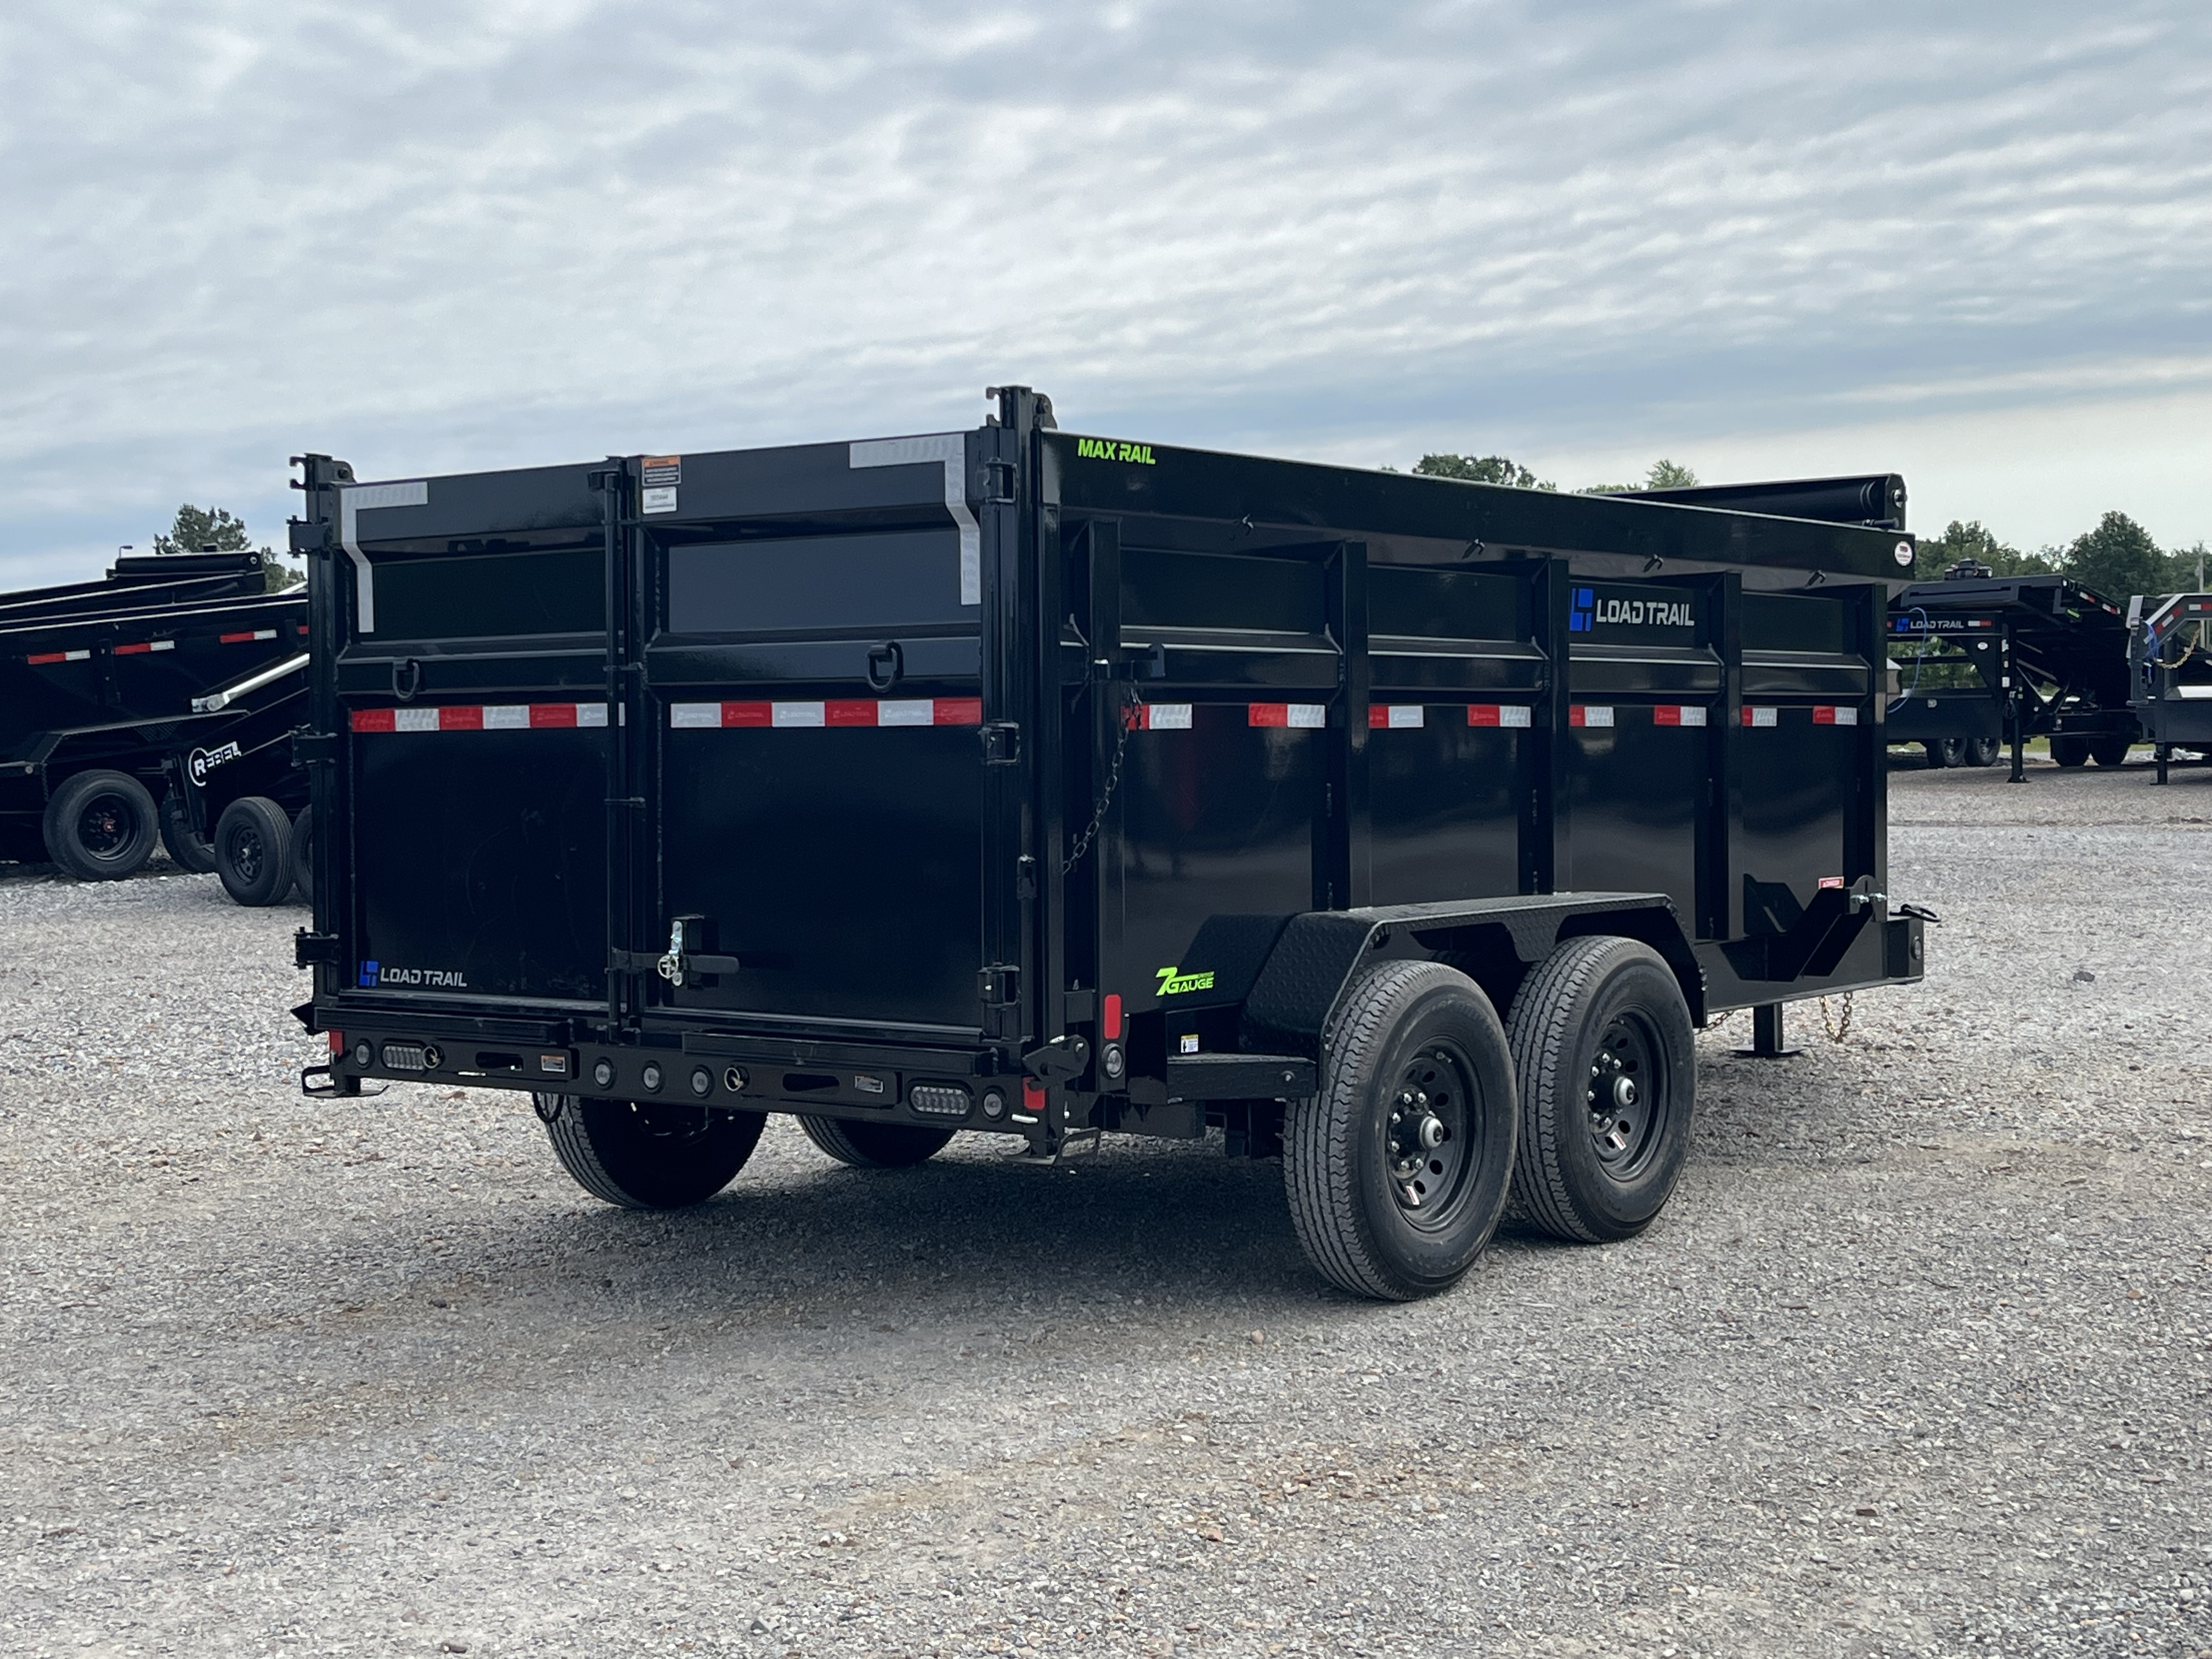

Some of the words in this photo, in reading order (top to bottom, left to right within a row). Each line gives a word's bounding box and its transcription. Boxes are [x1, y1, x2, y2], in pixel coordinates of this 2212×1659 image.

[1078, 438, 1117, 460] MAX
[1119, 443, 1156, 465] RAIL
[1596, 599, 1644, 624] LOAD
[1646, 601, 1695, 627] TRAIL
[1910, 620, 1936, 629] LOAD
[1937, 620, 1964, 629] TRAIL
[193, 741, 241, 776] REBEL
[380, 967, 421, 984] LOAD
[424, 970, 467, 987] TRAIL
